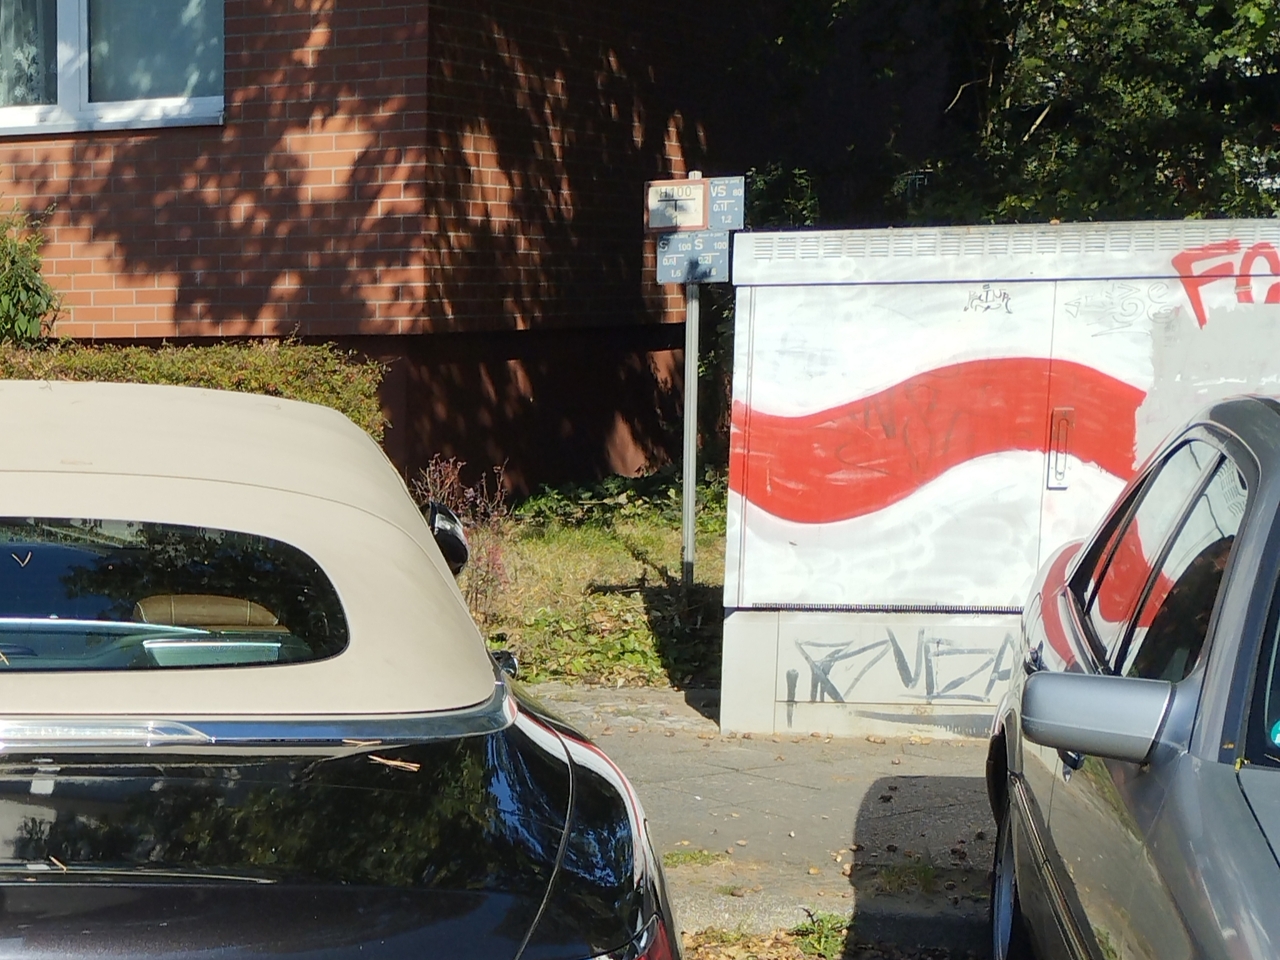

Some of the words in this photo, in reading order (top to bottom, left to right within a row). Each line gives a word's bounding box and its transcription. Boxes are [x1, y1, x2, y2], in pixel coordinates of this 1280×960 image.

[710, 185, 727, 197] VS
[694, 239, 704, 250] S
[713, 241, 727, 250] 100
